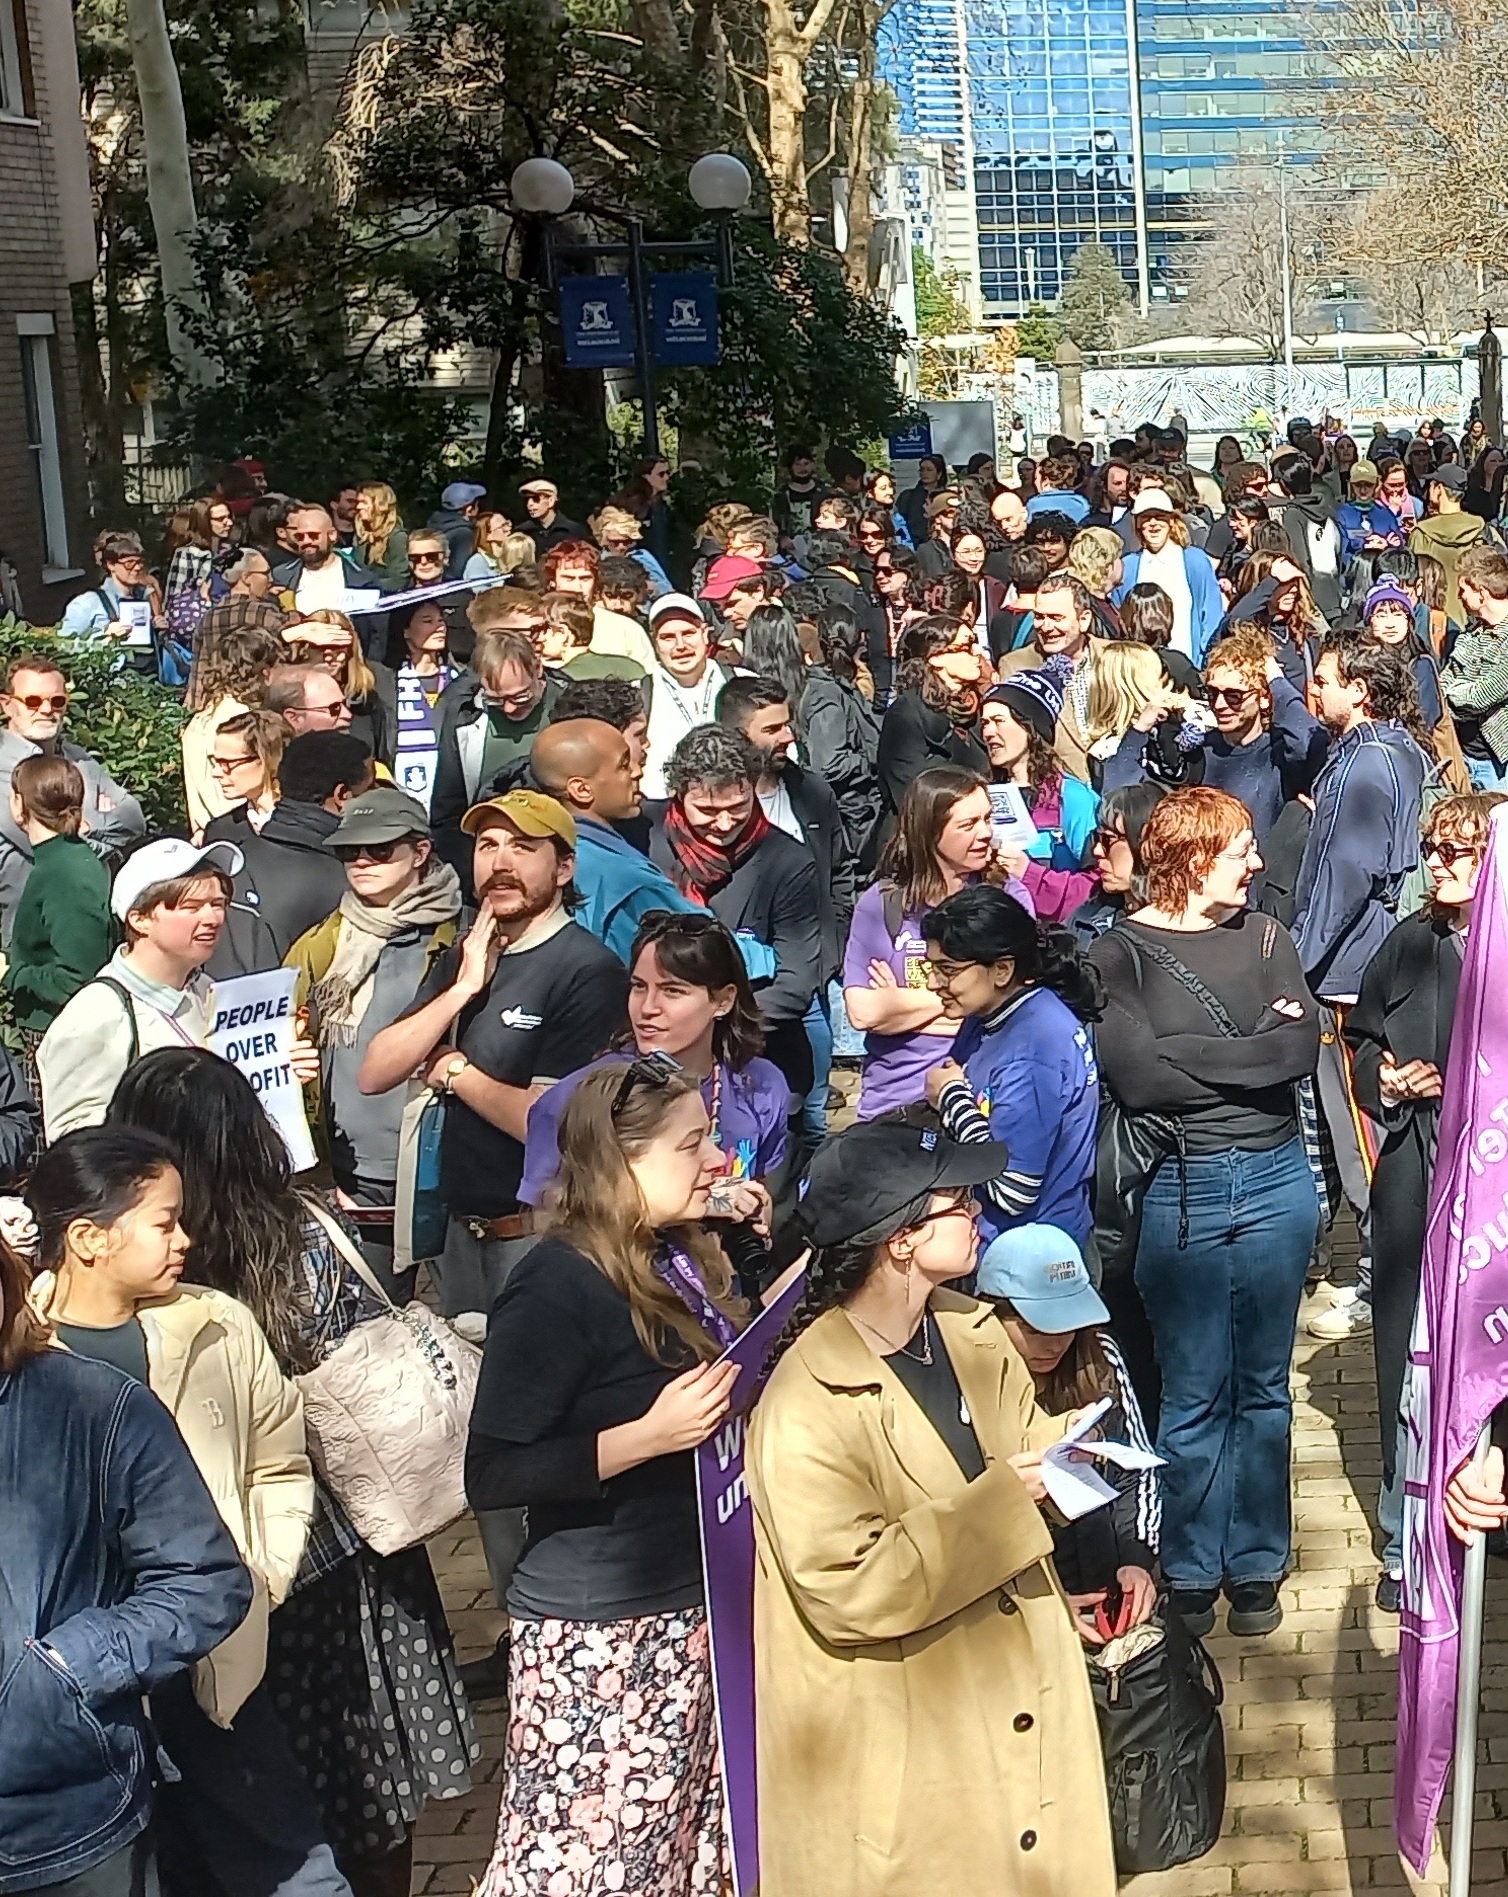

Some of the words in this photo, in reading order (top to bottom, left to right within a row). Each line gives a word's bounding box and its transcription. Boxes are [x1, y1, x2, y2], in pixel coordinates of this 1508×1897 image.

[215, 996, 289, 1032] PEOPLE
[226, 1032, 279, 1064] OVER
[250, 1063, 290, 1093] OFIT
